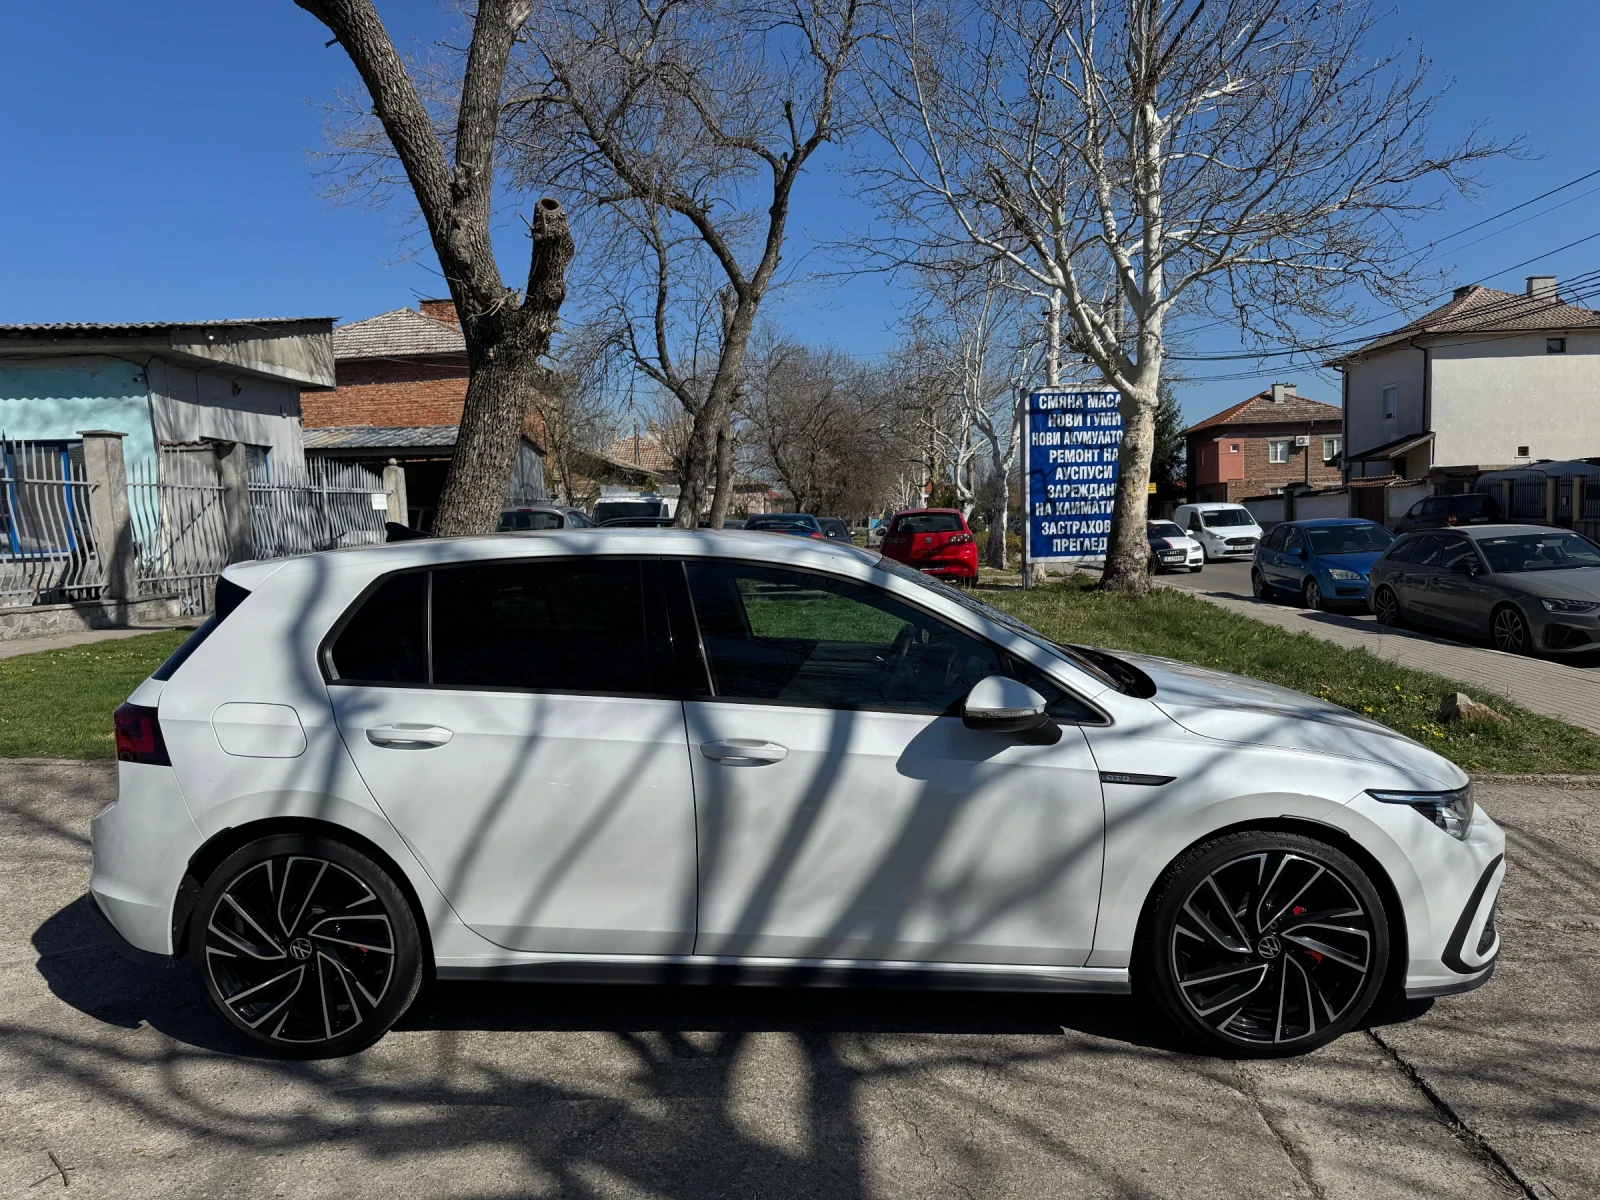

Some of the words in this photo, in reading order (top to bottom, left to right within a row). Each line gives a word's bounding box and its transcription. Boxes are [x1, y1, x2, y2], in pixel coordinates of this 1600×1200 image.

[1038, 395, 1084, 410] СМЯНА
[1047, 413, 1083, 428] НОВИ
[1086, 412, 1121, 427] ГУМИ
[1031, 431, 1061, 446] НОВИ
[1049, 449, 1100, 463] РЕМОНТ
[1103, 448, 1119, 462] НА
[1055, 466, 1113, 480] АУСПУСИ
[1047, 483, 1117, 499] ЗАРЕЖДАН
[1035, 502, 1052, 516] НА
